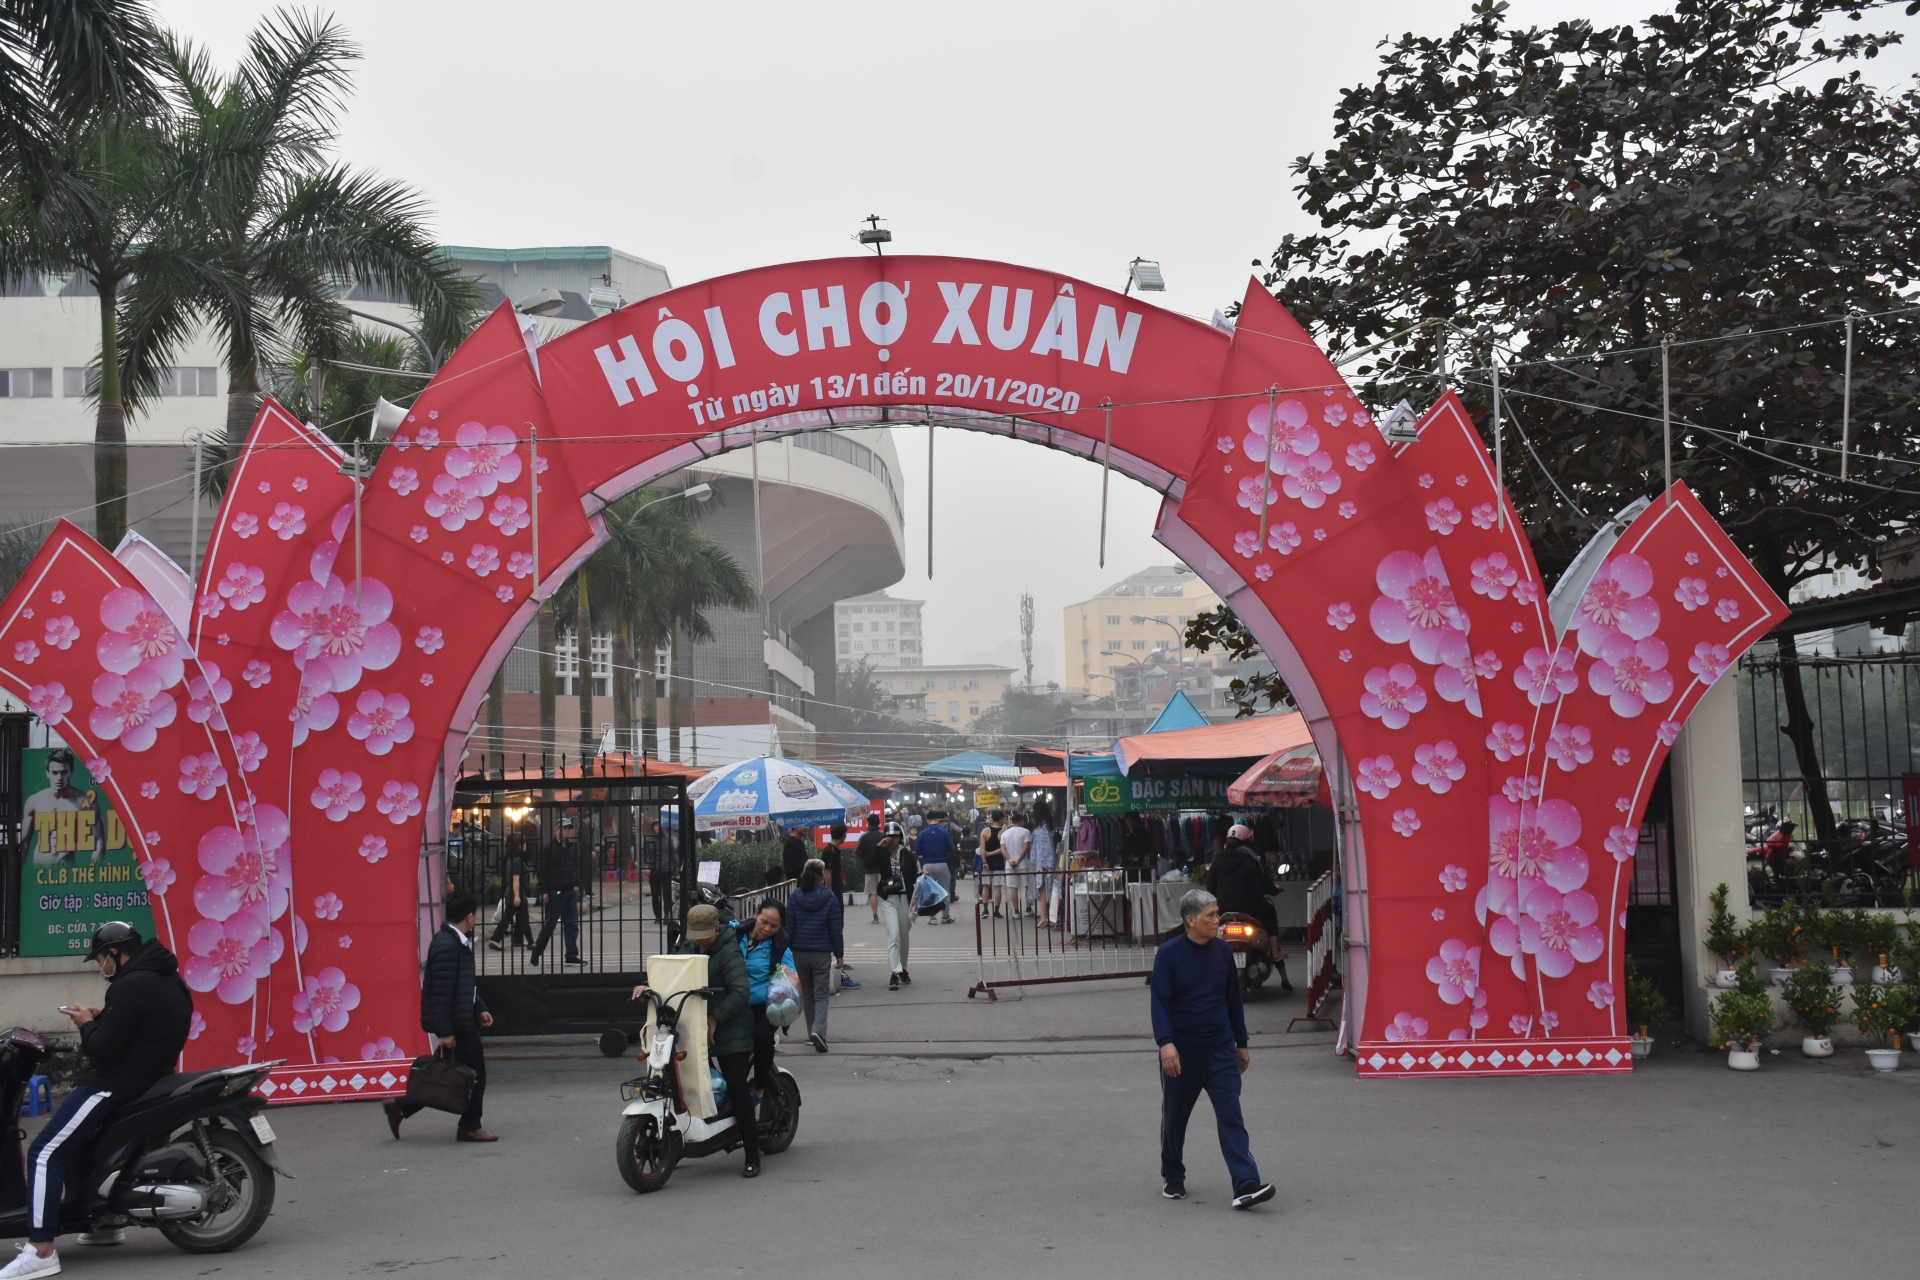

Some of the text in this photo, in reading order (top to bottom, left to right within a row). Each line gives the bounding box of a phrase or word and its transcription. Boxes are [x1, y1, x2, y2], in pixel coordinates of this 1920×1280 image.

[593, 280, 1143, 408] HỘI CHỢ XUÂN
[686, 398, 731, 427] Từ
[731, 381, 800, 416] ngày
[812, 372, 869, 401] 13/1
[873, 366, 926, 397] đến
[935, 371, 1082, 416] 20/1/2020
[1131, 777, 1165, 802] ĐẶC
[1170, 773, 1204, 797] SẢN
[1208, 777, 1229, 796] VÙ
[34, 789, 96, 853] THỂ
[36, 868, 68, 885] C.L.B
[71, 859, 97, 884] THỂ
[99, 862, 131, 883] HÌNH
[39, 894, 61, 911] Giờ
[64, 893, 83, 913] tập
[93, 892, 123, 911] Sáng
[48, 924, 65, 935] ĐC:
[67, 919, 88, 934] CỬA
[90, 922, 97, 933] 7
[68, 938, 81, 949] 55
